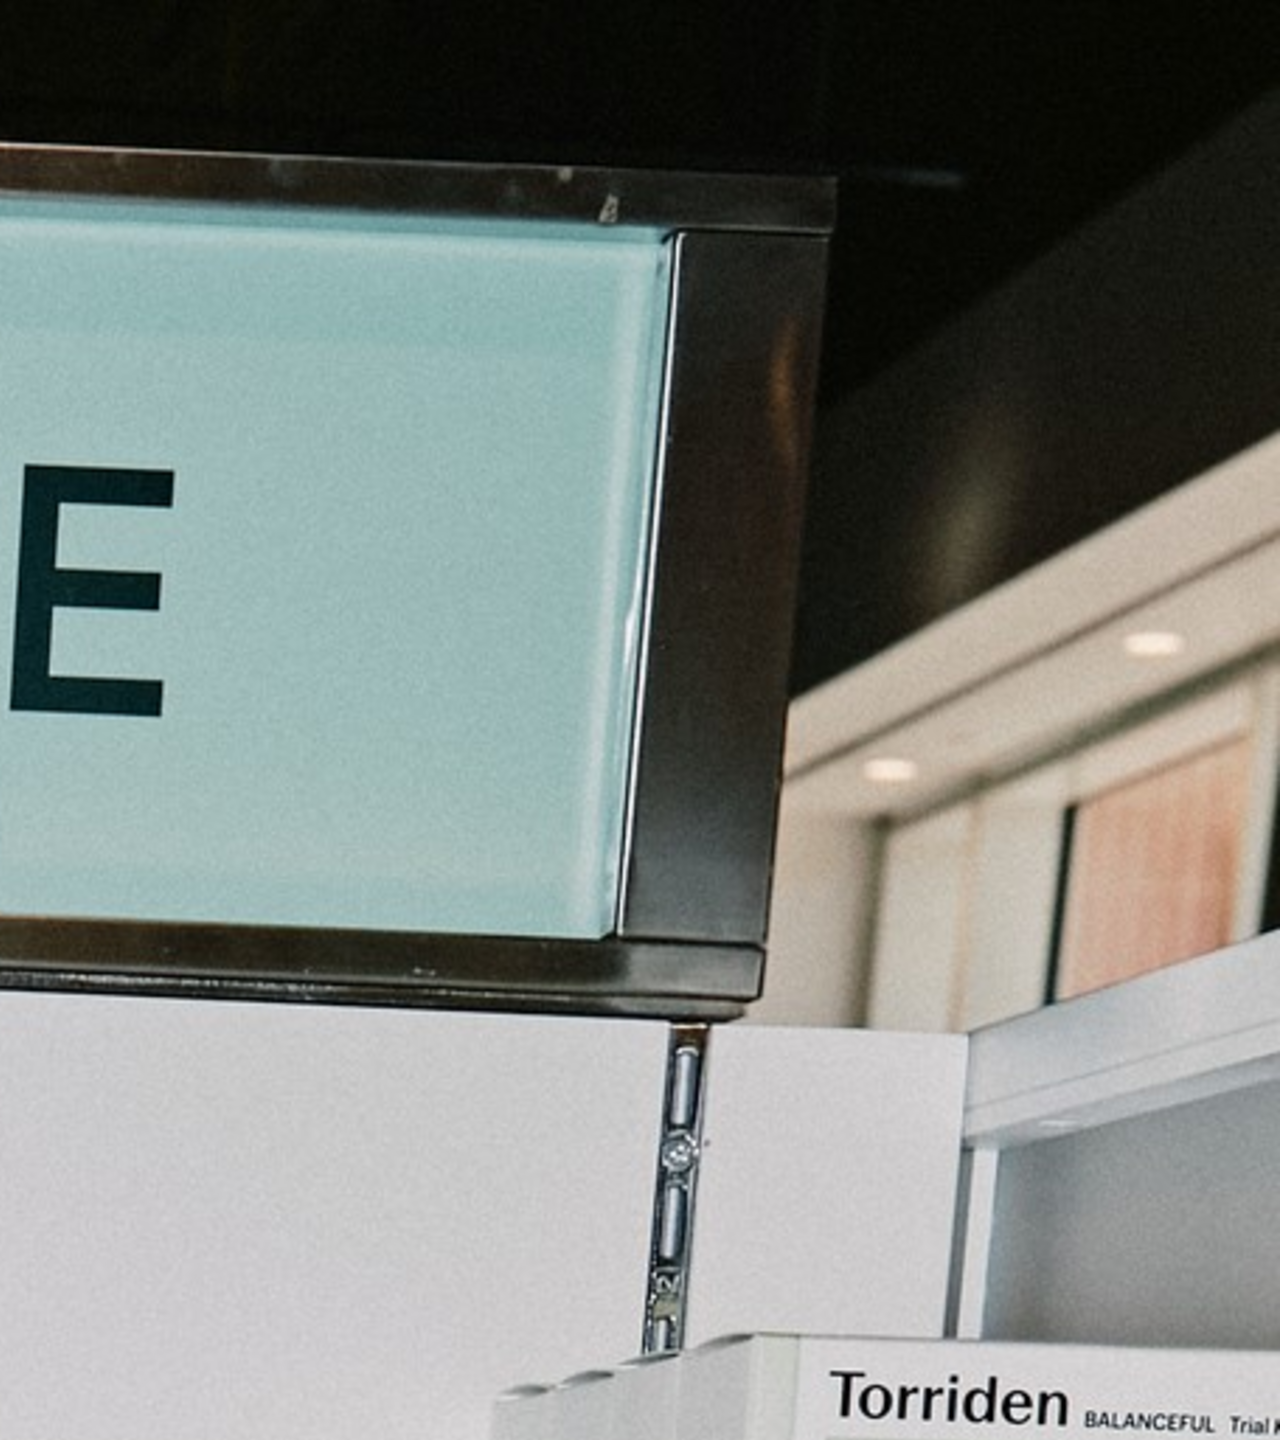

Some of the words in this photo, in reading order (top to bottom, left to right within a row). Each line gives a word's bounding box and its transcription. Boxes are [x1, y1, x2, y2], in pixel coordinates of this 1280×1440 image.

[829, 1370, 1069, 1428] Torriden
[1085, 1410, 1216, 1435] BALANCEFUL
[1230, 1414, 1269, 1436] Trial
